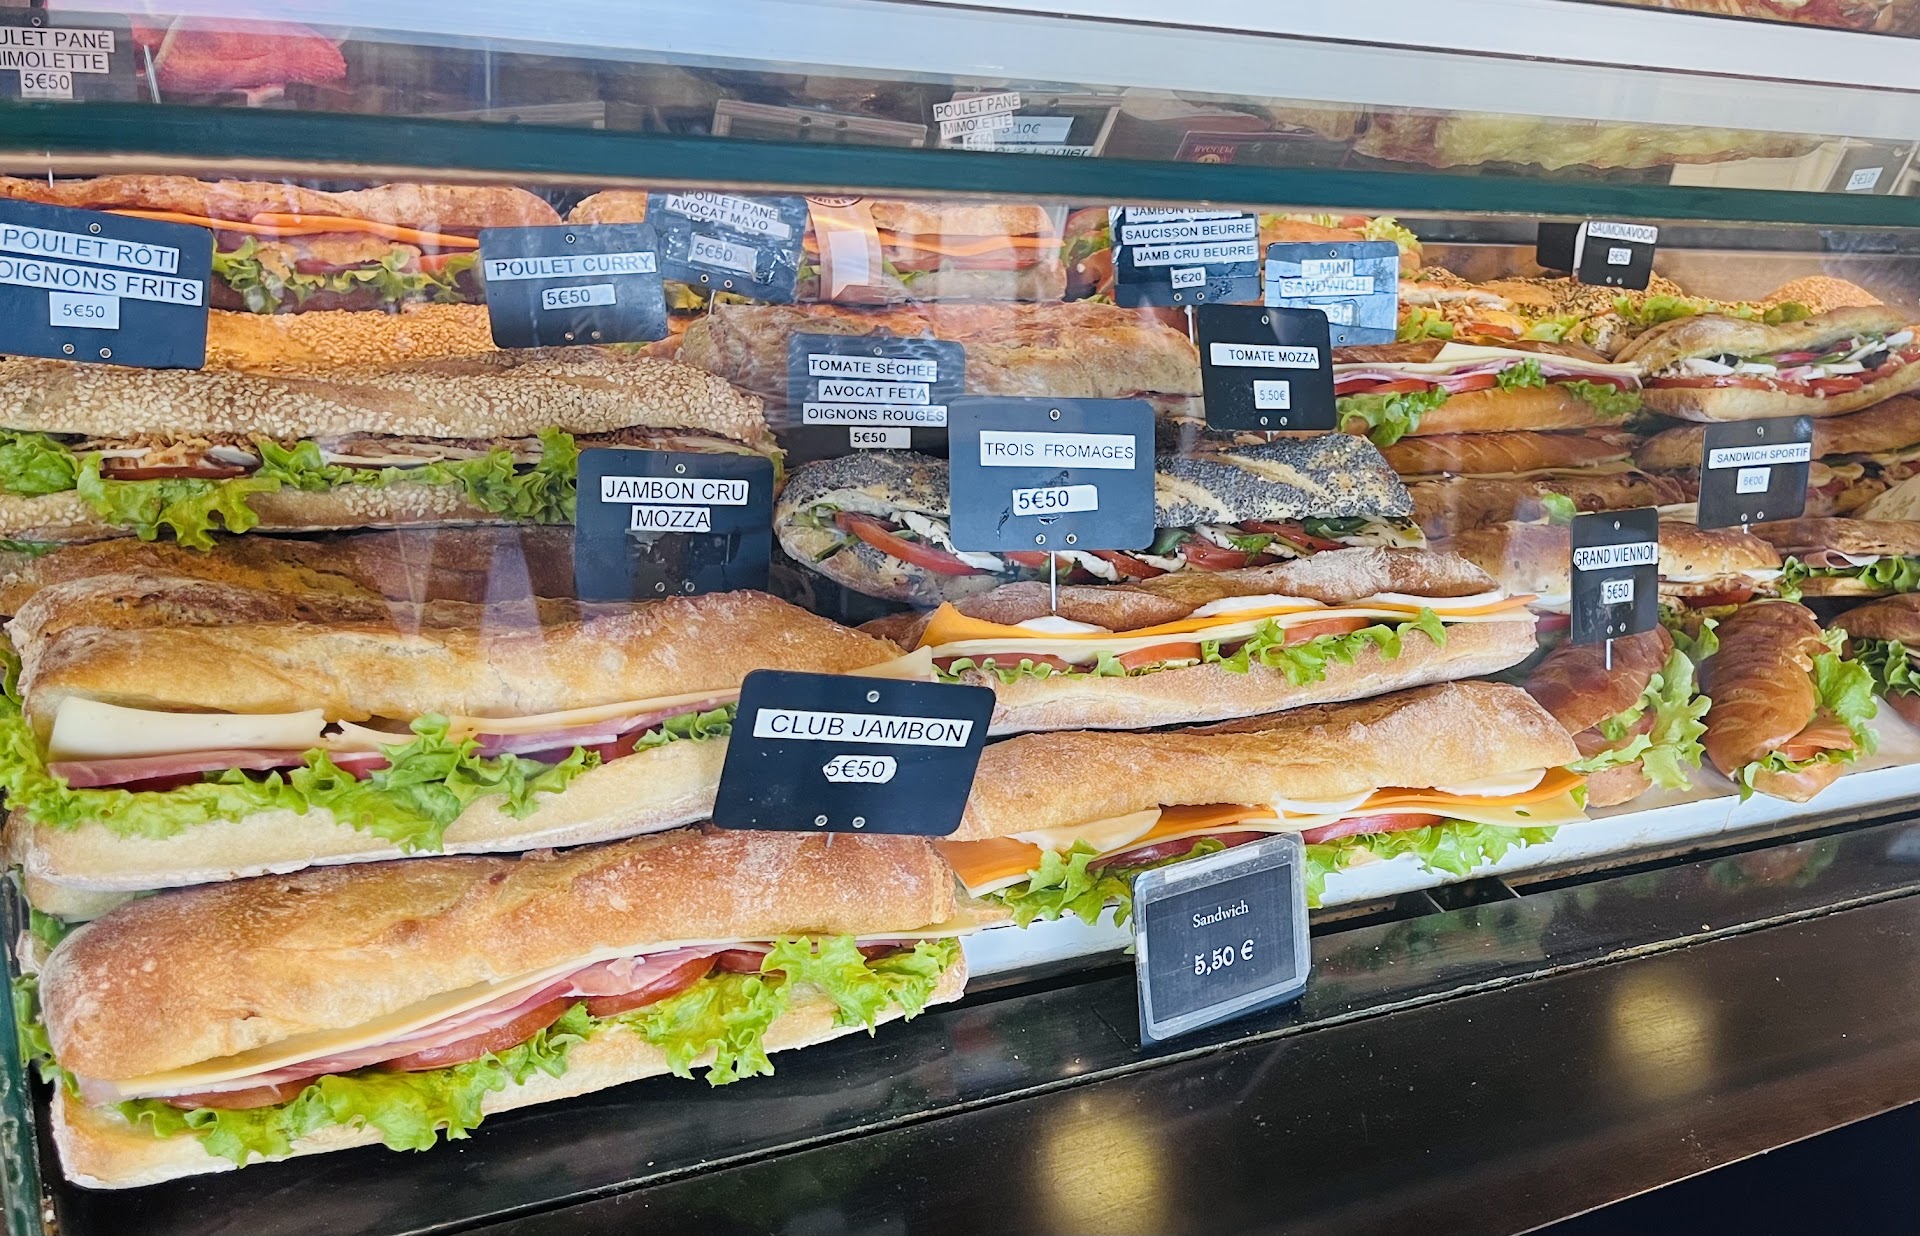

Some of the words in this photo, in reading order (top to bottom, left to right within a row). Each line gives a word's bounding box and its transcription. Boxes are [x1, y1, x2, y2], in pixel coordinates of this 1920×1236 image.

[55, 31, 110, 49] PANÉ
[0, 50, 105, 70] IMOLETTE
[24, 73, 70, 90] 5€50
[935, 100, 984, 118] POULET
[943, 114, 1011, 135] MIMOLETTE
[683, 191, 737, 210] POULET
[672, 198, 727, 220] AVOCAT
[730, 213, 768, 231] MAYO
[1125, 227, 1197, 240] SAUCISSON
[1202, 224, 1252, 236] BEURRE
[4, 229, 109, 259] POULET
[117, 244, 176, 269] RÔTI
[695, 243, 733, 262] 5€50
[1137, 250, 1170, 262] JAMB
[1174, 248, 1199, 260] CRU
[1204, 246, 1254, 258] BEURRE
[1610, 250, 1628, 262] 5€50
[496, 258, 575, 276] POULET
[583, 255, 650, 272] CURRY
[1319, 261, 1350, 274] MINI
[0, 260, 117, 291] OIGNONS
[126, 276, 197, 301] FRITS
[1174, 272, 1202, 284] 5€20
[1284, 279, 1366, 294] SANDWICH
[547, 289, 591, 305] 5€50
[63, 303, 105, 319] 5€50
[1229, 349, 1275, 362] TOMATE
[1279, 351, 1317, 363] MOZZA
[809, 359, 872, 373] TOMATE
[876, 361, 936, 377] SÉCHÉE
[823, 385, 884, 398] AVOCAT
[808, 408, 877, 421] OIGNONS
[883, 409, 945, 422] ROUGES
[853, 432, 887, 443] 5€50
[984, 442, 1034, 457] TROIS
[1044, 444, 1134, 459] FROMAGES
[1717, 450, 1767, 463] SANDWICH
[1770, 447, 1808, 459] SPORTIF
[605, 480, 695, 499] JAMBON
[702, 483, 744, 501] CRU
[1018, 490, 1069, 510] 5€50
[636, 509, 710, 528] MOZZA
[1575, 548, 1610, 567] GRAND
[1607, 583, 1629, 599] 5€50
[771, 714, 844, 736] CLUB
[852, 718, 965, 742] JAMBON
[826, 759, 885, 778] 5€50
[1192, 899, 1249, 928] Sandwich
[1194, 945, 1235, 976] 5,50
[1240, 938, 1254, 961] €
